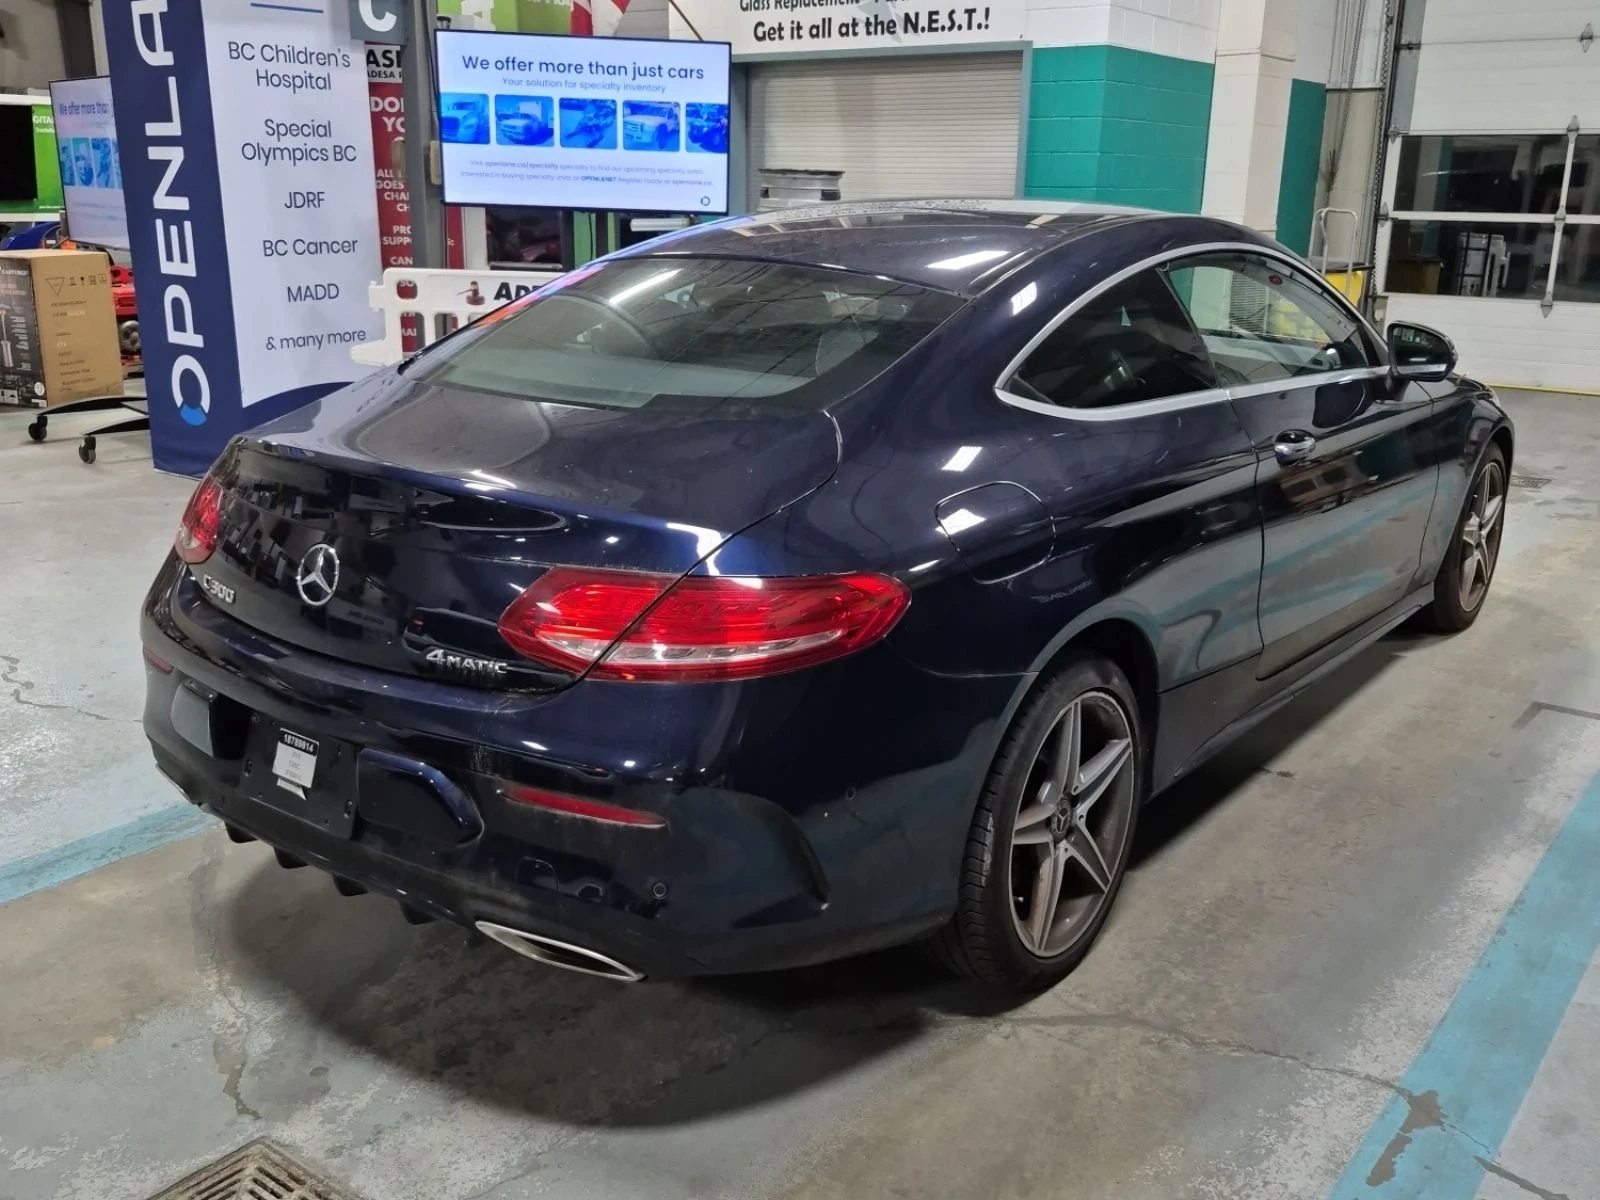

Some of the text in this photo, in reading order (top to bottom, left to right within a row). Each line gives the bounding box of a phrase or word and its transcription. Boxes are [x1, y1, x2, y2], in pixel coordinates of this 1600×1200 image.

[359, 0, 397, 32] C
[740, 0, 770, 12] Glass
[753, 7, 990, 42] Get it all at the N.E.S.T.!
[228, 41, 351, 68] BC Children's
[462, 55, 704, 81] We offer more than just cars
[256, 68, 331, 94] Hospital
[502, 77, 666, 94] Your solution for specialty inventory
[264, 118, 332, 142] Special
[241, 142, 357, 166] Olympics BC
[285, 191, 325, 209] JDRF
[263, 238, 358, 257] BC Cancer
[287, 283, 340, 302] MADD
[266, 330, 367, 350] & many more
[426, 649, 507, 674] 4MATIC
